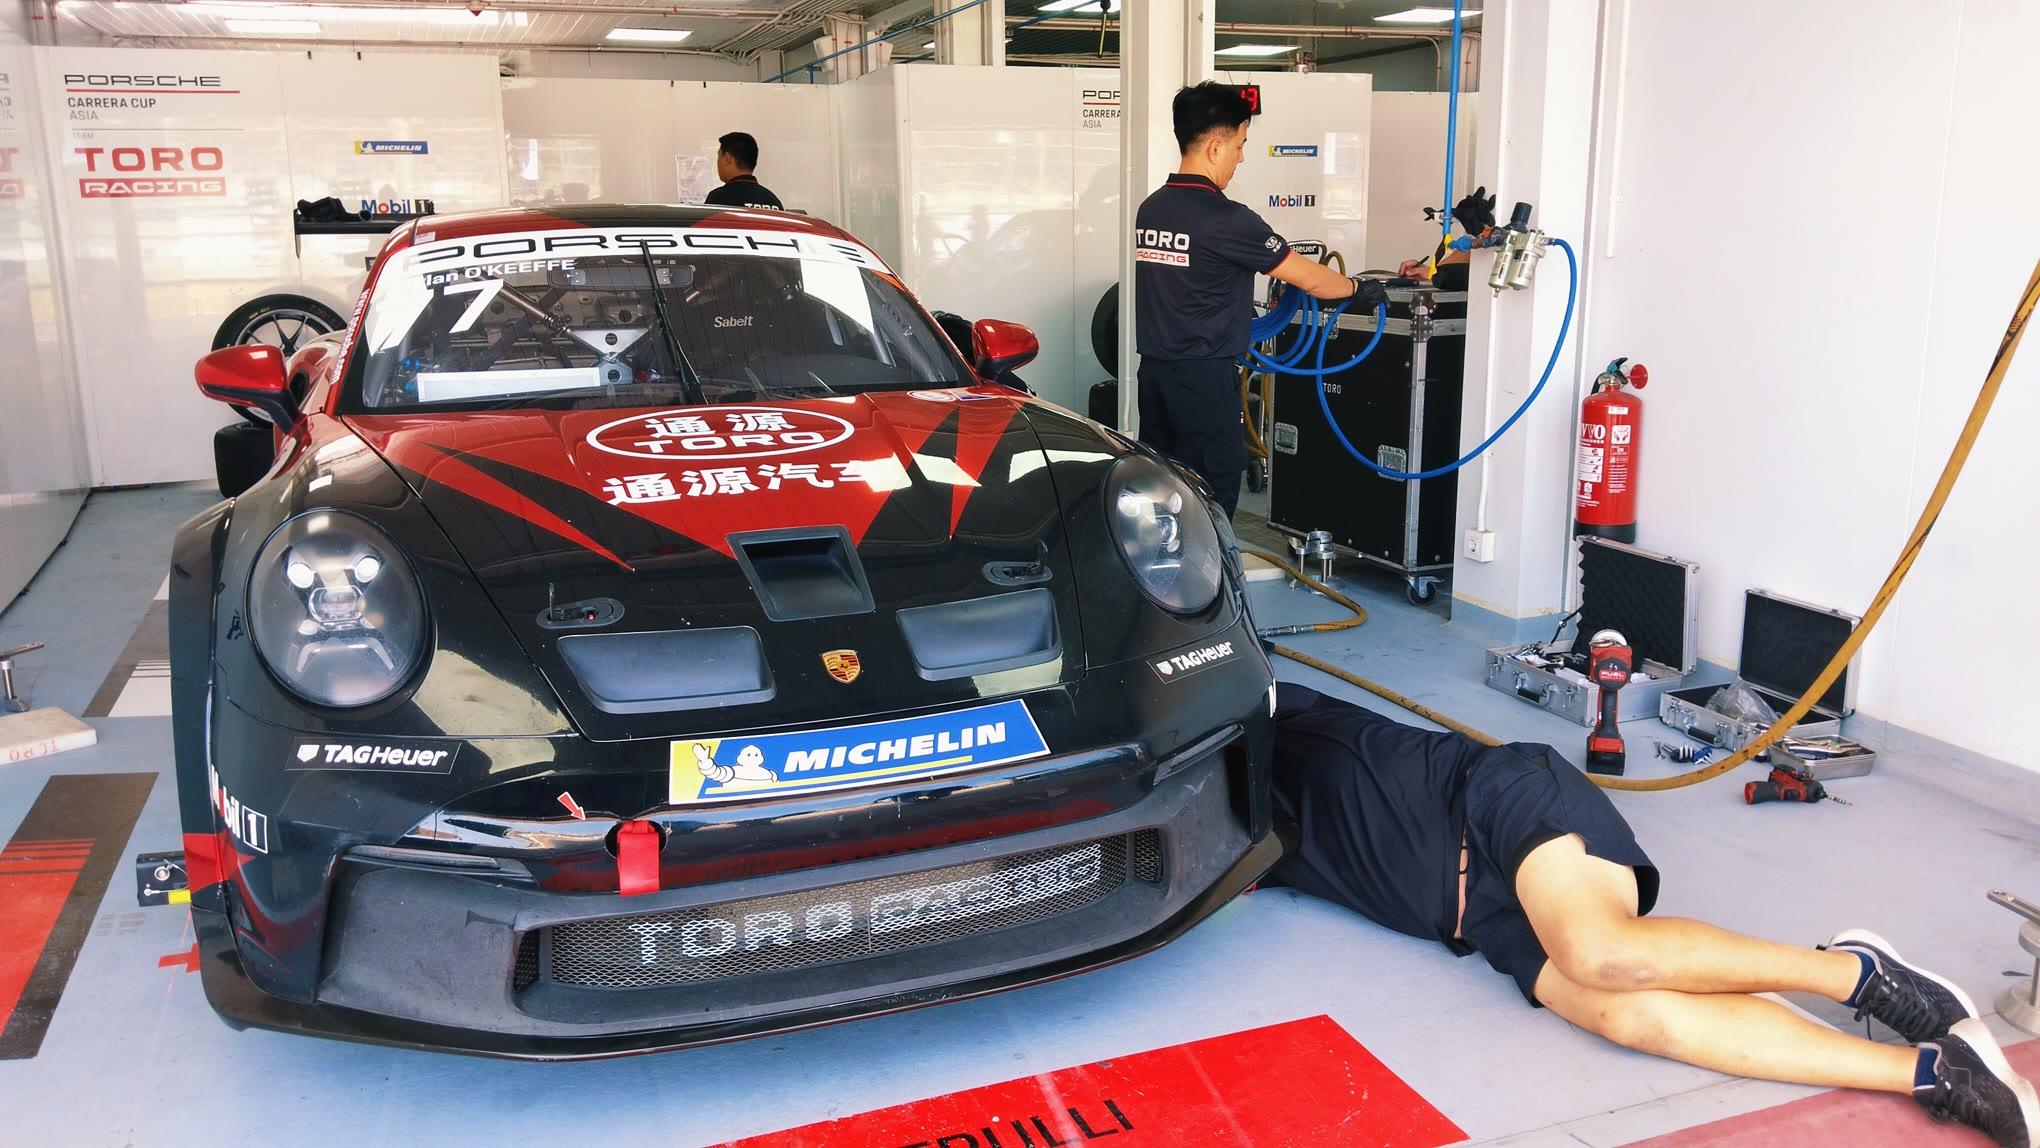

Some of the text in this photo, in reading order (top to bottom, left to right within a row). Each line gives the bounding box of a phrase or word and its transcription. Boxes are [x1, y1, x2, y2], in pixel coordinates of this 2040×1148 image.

[64, 74, 221, 87] PORSCHE
[67, 97, 156, 109] CARRERA CUP
[69, 109, 99, 121] ASIA
[1082, 119, 1102, 129] ASIA
[73, 132, 94, 140] TEAM
[74, 147, 224, 172] TORO
[84, 180, 221, 195] RACING
[361, 199, 411, 214] Mobil
[1268, 195, 1302, 207] Mobil
[1136, 229, 1190, 251] TORO
[1290, 245, 1317, 253] Heuer
[1137, 250, 1187, 264] RACING
[464, 259, 576, 279] O'KEEFFE
[713, 315, 754, 328] Sabelt
[1322, 382, 1342, 395] TORO
[645, 412, 798, 439] 通源
[633, 431, 826, 454] TORO
[783, 722, 1006, 773] MICHELIN
[628, 900, 852, 967] TORO
